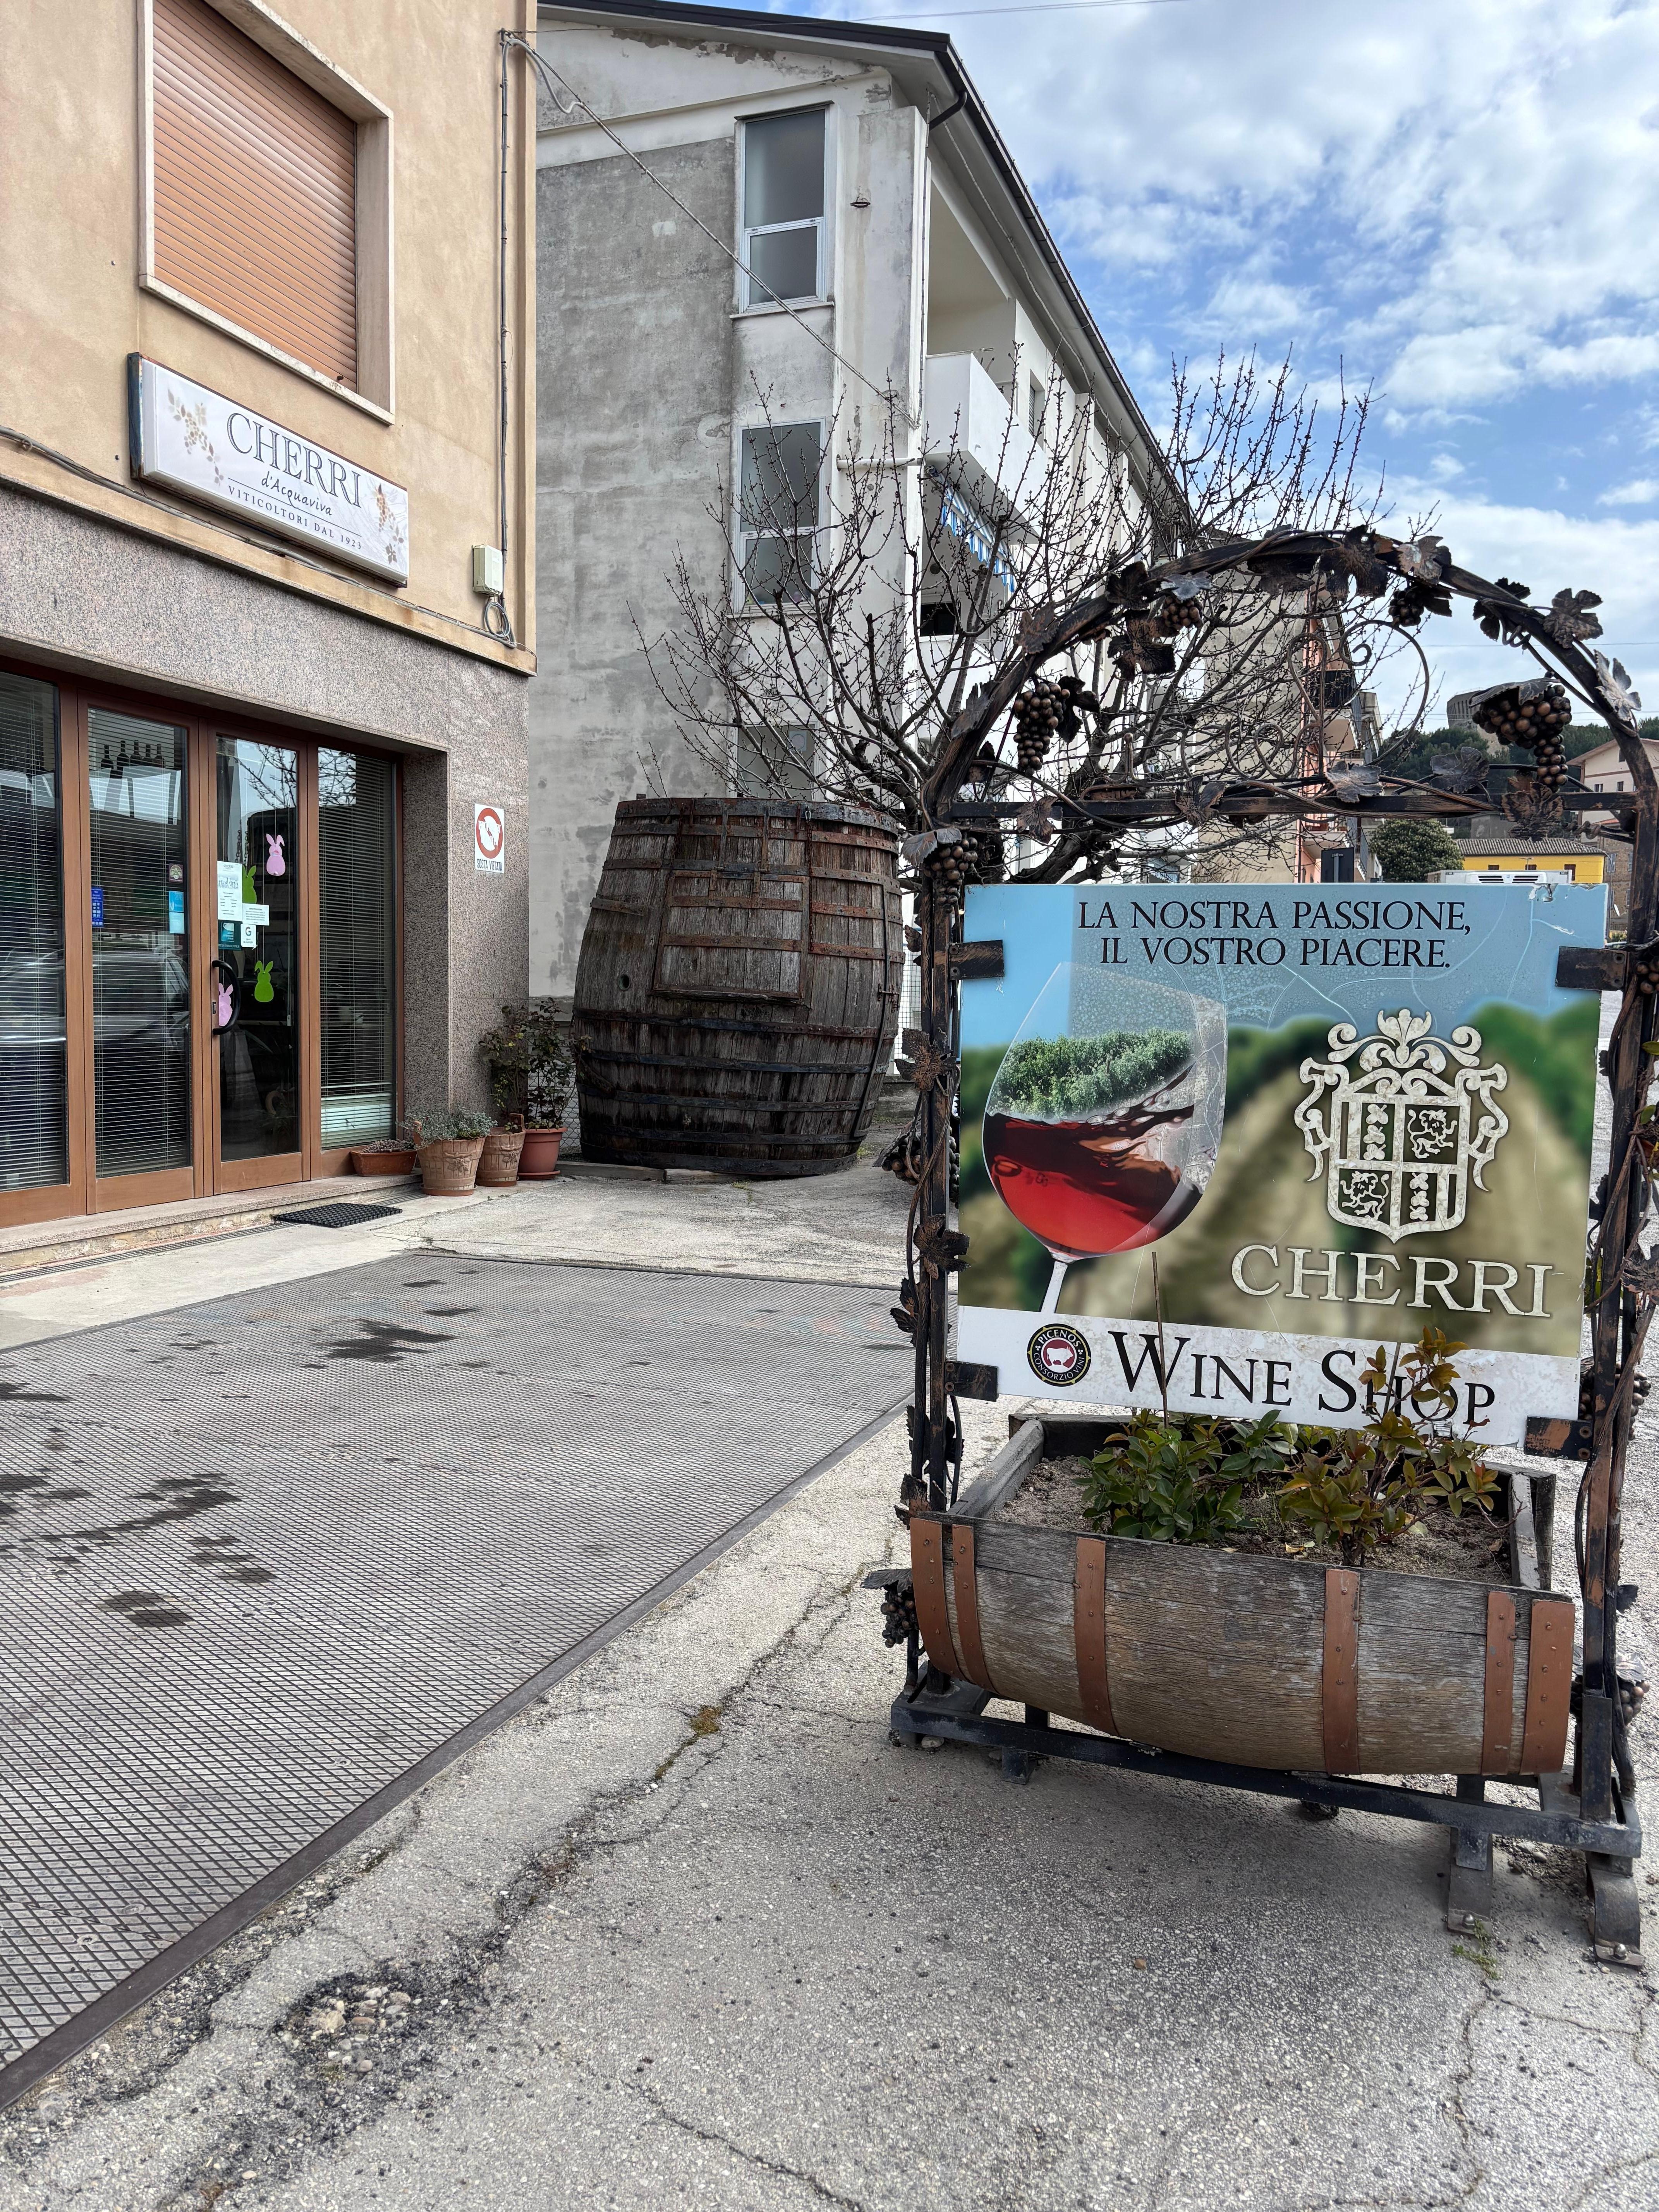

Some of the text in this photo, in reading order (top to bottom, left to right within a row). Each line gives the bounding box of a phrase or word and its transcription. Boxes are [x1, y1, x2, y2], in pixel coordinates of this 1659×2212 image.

[227, 413, 362, 508] CHERRI
[261, 471, 332, 515] d'Acquaviva
[228, 485, 361, 549] VITICOLTORI DAL 1923
[477, 859, 503, 871] SOSTA VIETATA
[1078, 901, 1471, 936] LA NOSTRA PASSIONE,
[1100, 937, 1451, 969] IL VOSTRO PIACERE.
[1231, 1244, 1553, 1317] CHERRI
[1037, 1329, 1081, 1347] PICENOS
[1034, 1353, 1085, 1381] CONSORZIO VINI
[1107, 1331, 1292, 1406] WINE
